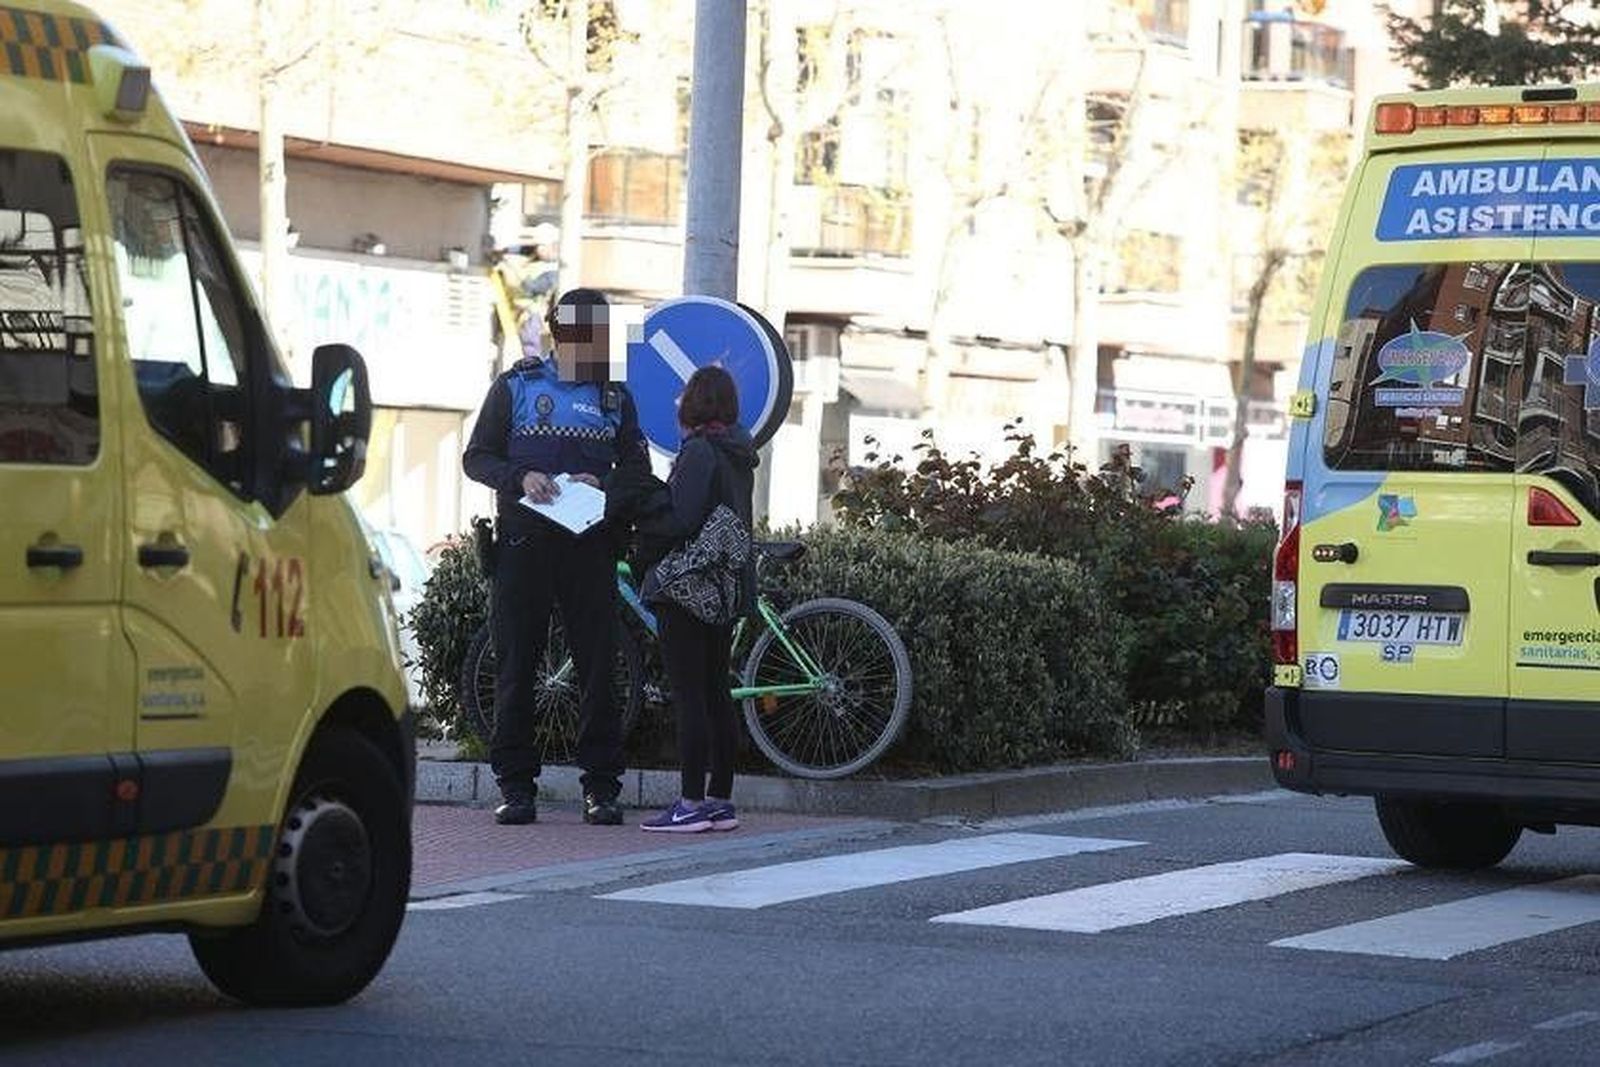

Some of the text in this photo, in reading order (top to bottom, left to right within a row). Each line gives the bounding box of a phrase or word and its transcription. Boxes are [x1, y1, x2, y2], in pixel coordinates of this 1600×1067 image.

[1411, 166, 1600, 197] AMBULAN
[1405, 203, 1600, 234] ASISTENC
[254, 557, 304, 638] 112
[1351, 594, 1428, 606] MASTER
[1354, 613, 1461, 641] 3037 HTW
[1384, 644, 1412, 661] SP
